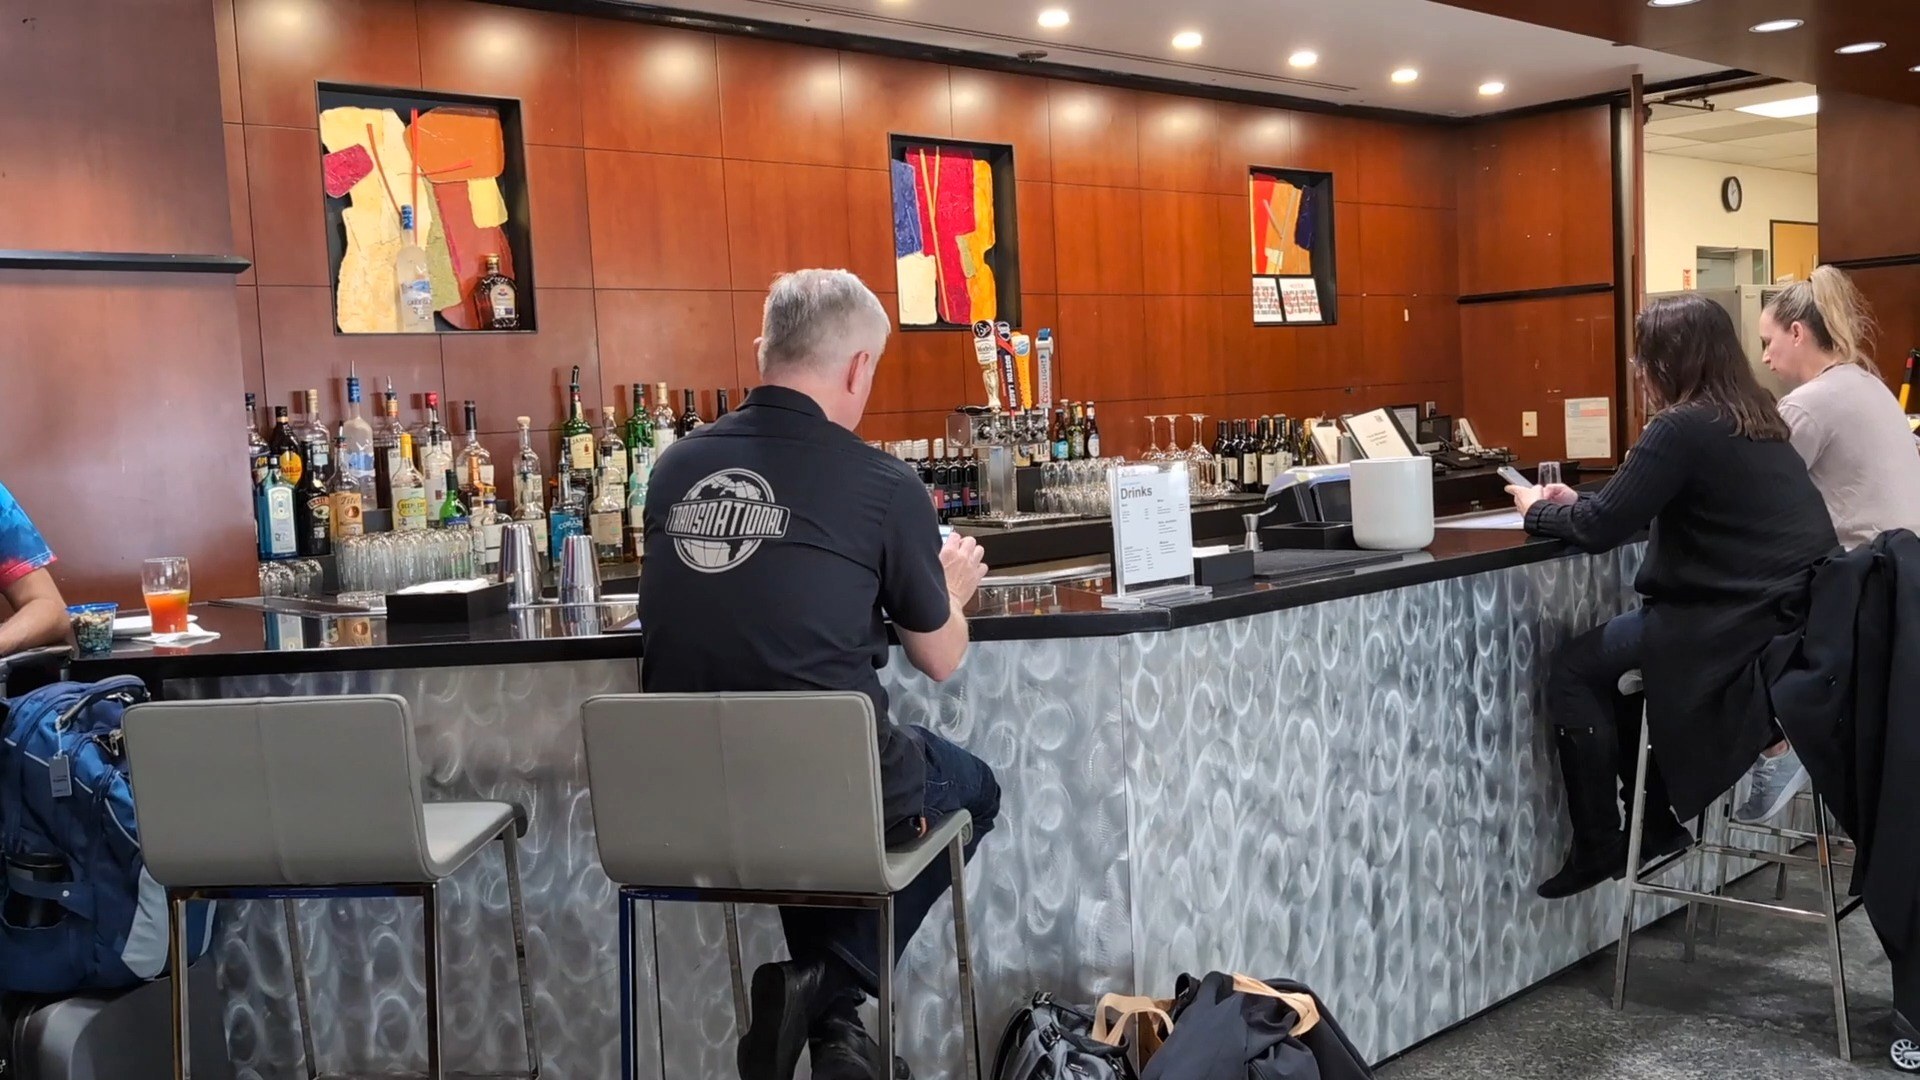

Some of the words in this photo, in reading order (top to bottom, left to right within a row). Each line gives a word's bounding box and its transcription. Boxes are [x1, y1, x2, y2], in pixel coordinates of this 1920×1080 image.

[1004, 355, 1014, 383] BOSTON
[1007, 384, 1017, 407] LAGER
[1120, 486, 1153, 500] Drinks
[668, 500, 784, 537] TRANSNATIONAL
